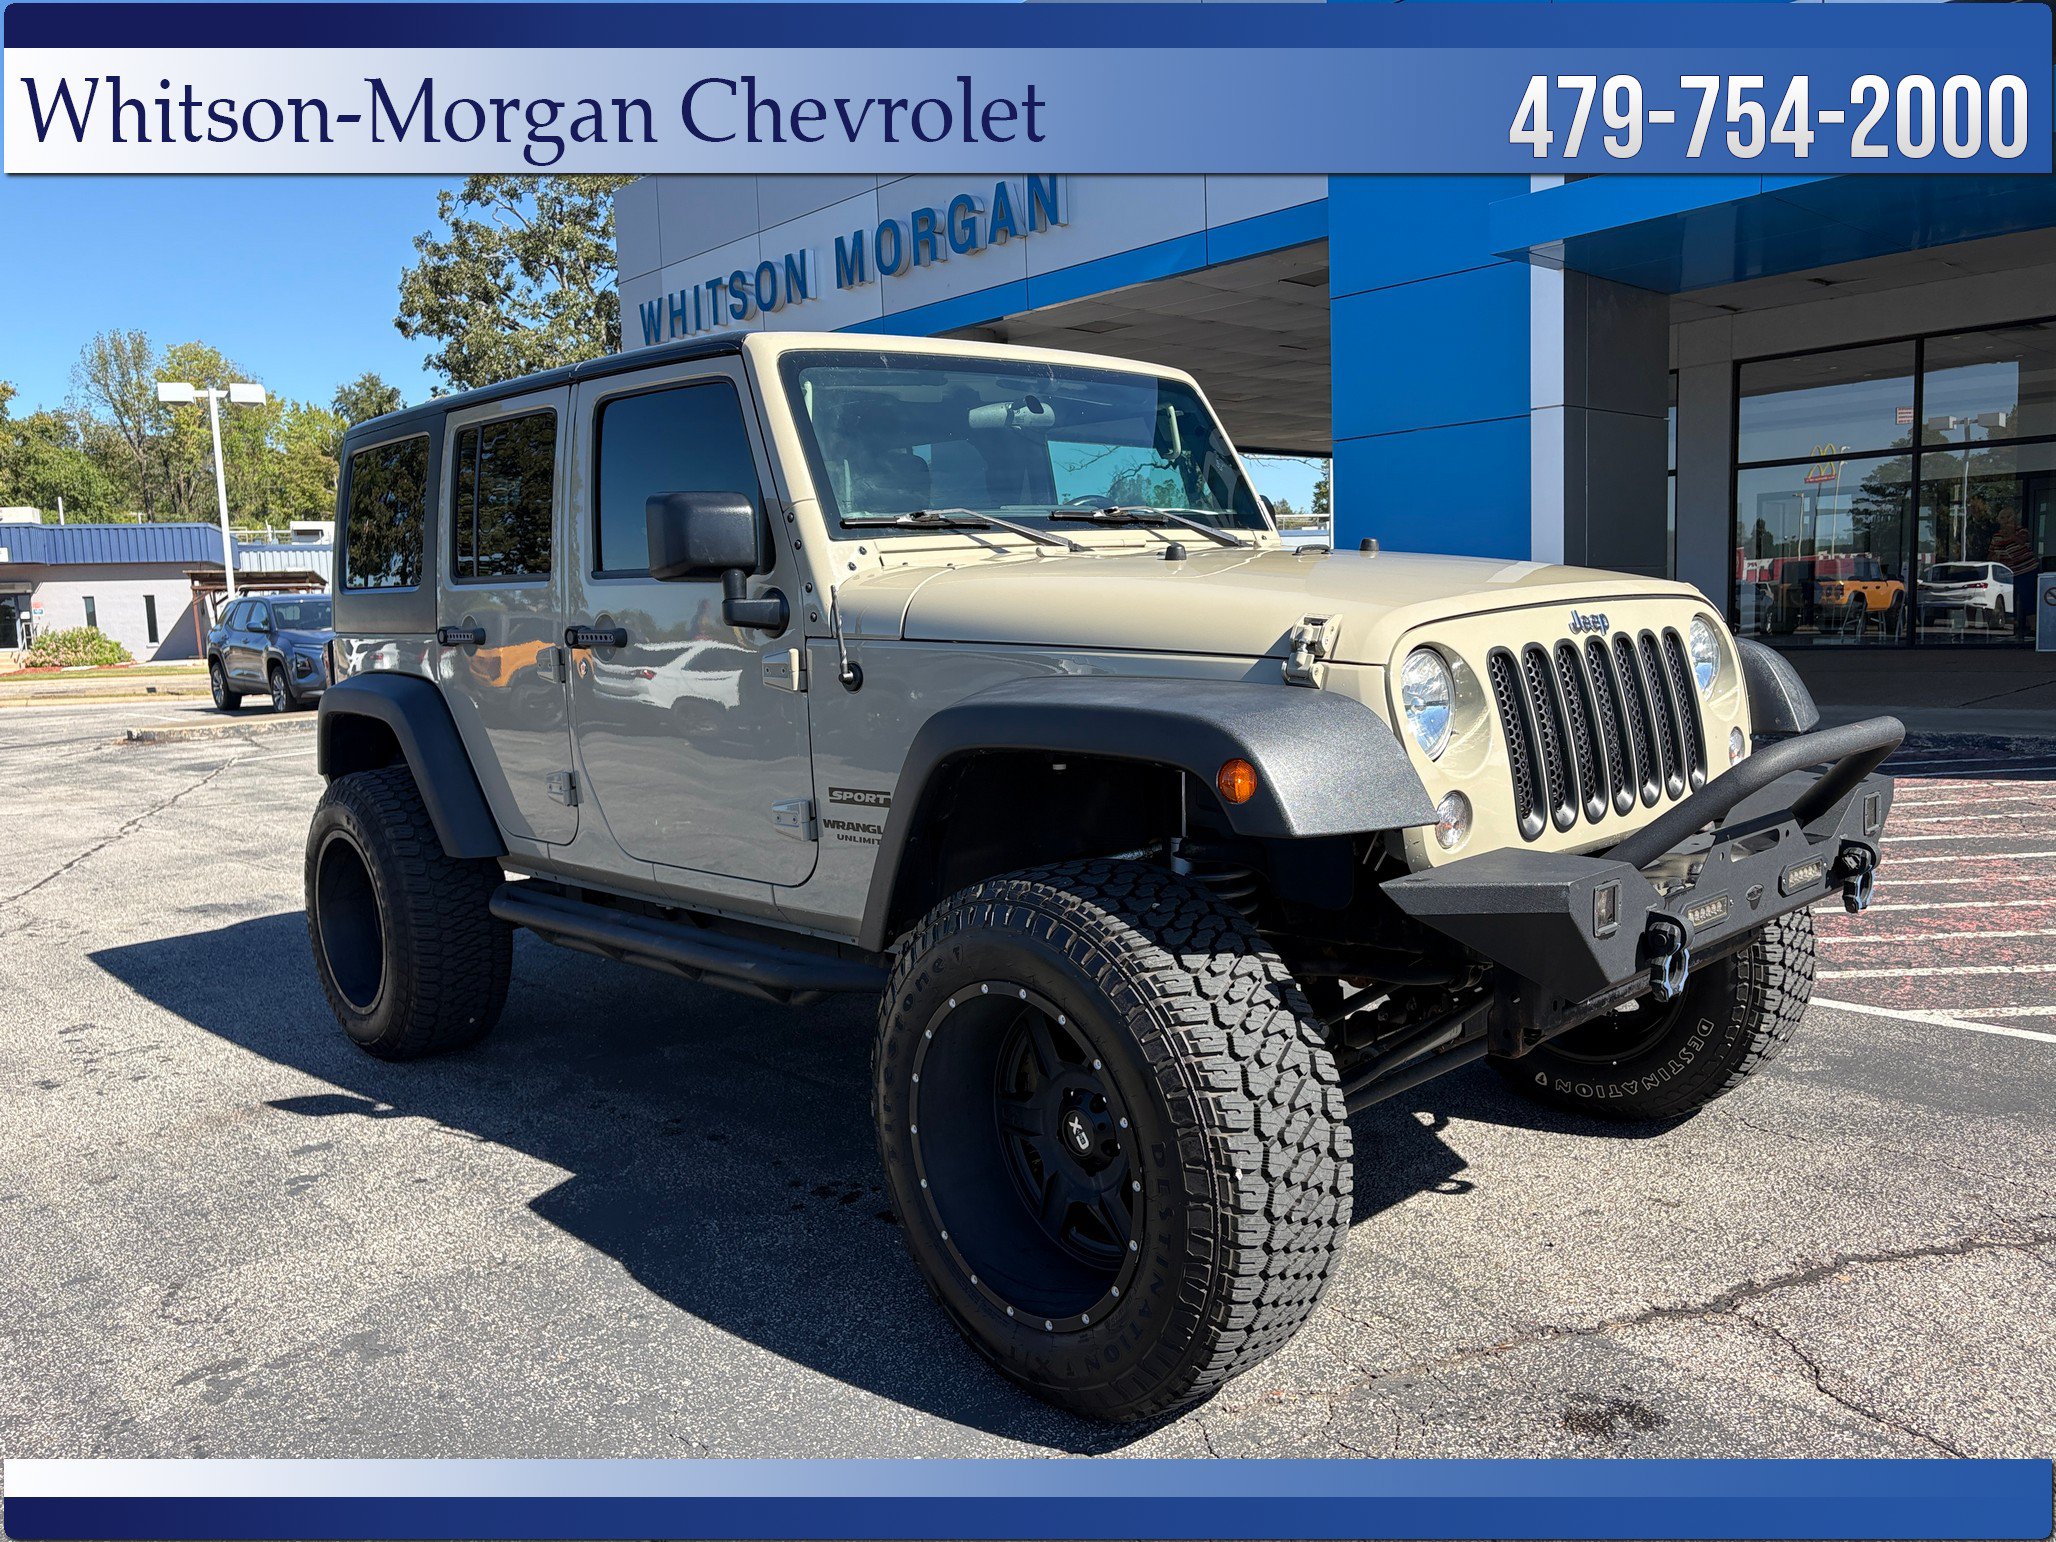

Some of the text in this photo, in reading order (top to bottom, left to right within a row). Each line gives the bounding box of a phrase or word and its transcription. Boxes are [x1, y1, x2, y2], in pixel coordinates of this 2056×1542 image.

[639, 174, 1068, 347] WHITSON MORGAN
[1568, 610, 1609, 636] Jeep
[831, 790, 891, 804] SPORT
[1555, 1017, 1715, 1099] DESTINATION
[1083, 1141, 1175, 1374] DESTINATION
